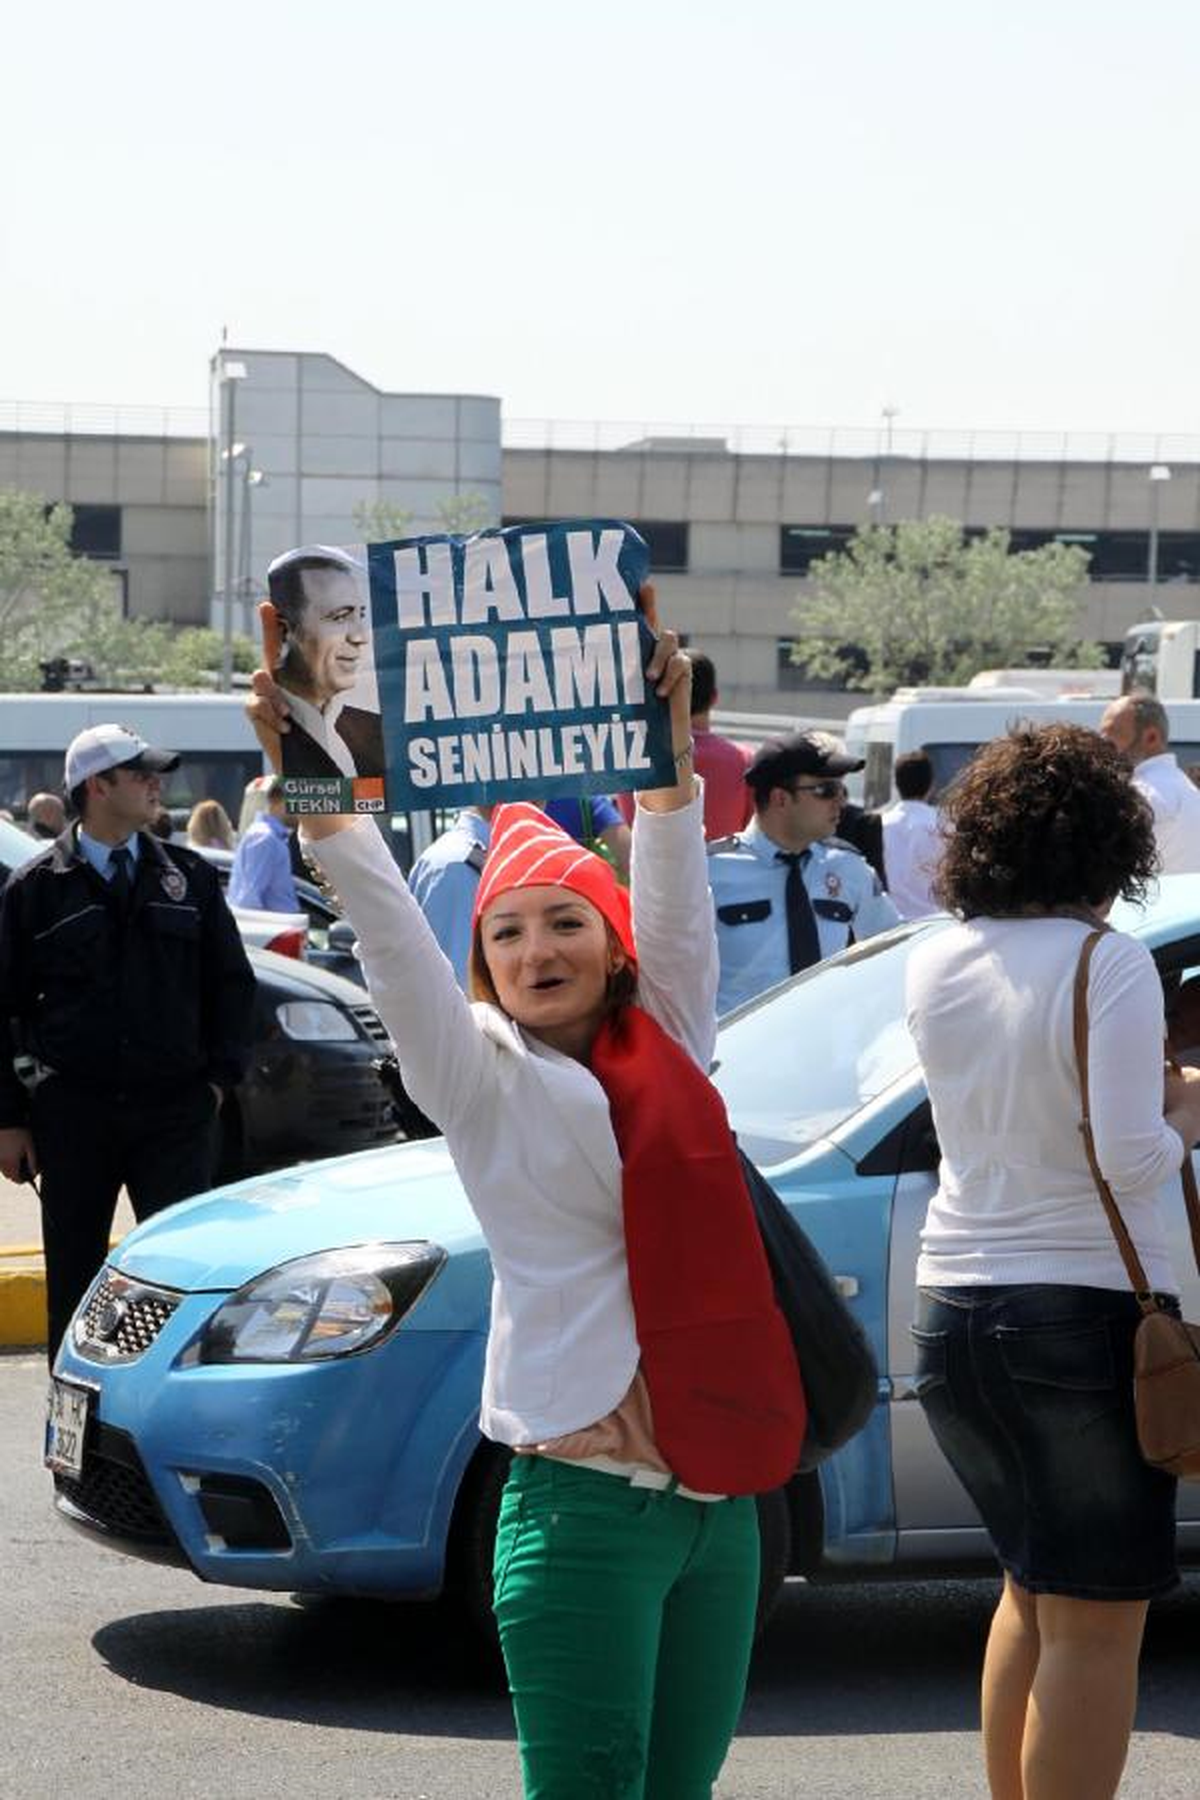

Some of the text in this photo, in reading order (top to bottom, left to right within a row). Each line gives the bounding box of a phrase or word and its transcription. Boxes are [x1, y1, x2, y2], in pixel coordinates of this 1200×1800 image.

[393, 529, 635, 629] HALK
[404, 621, 645, 723] ADAMI
[407, 714, 651, 788] SENİNLEYİZ
[284, 779, 341, 795] Gürsel
[287, 797, 341, 813] TEKİN
[357, 800, 383, 811] CHP
